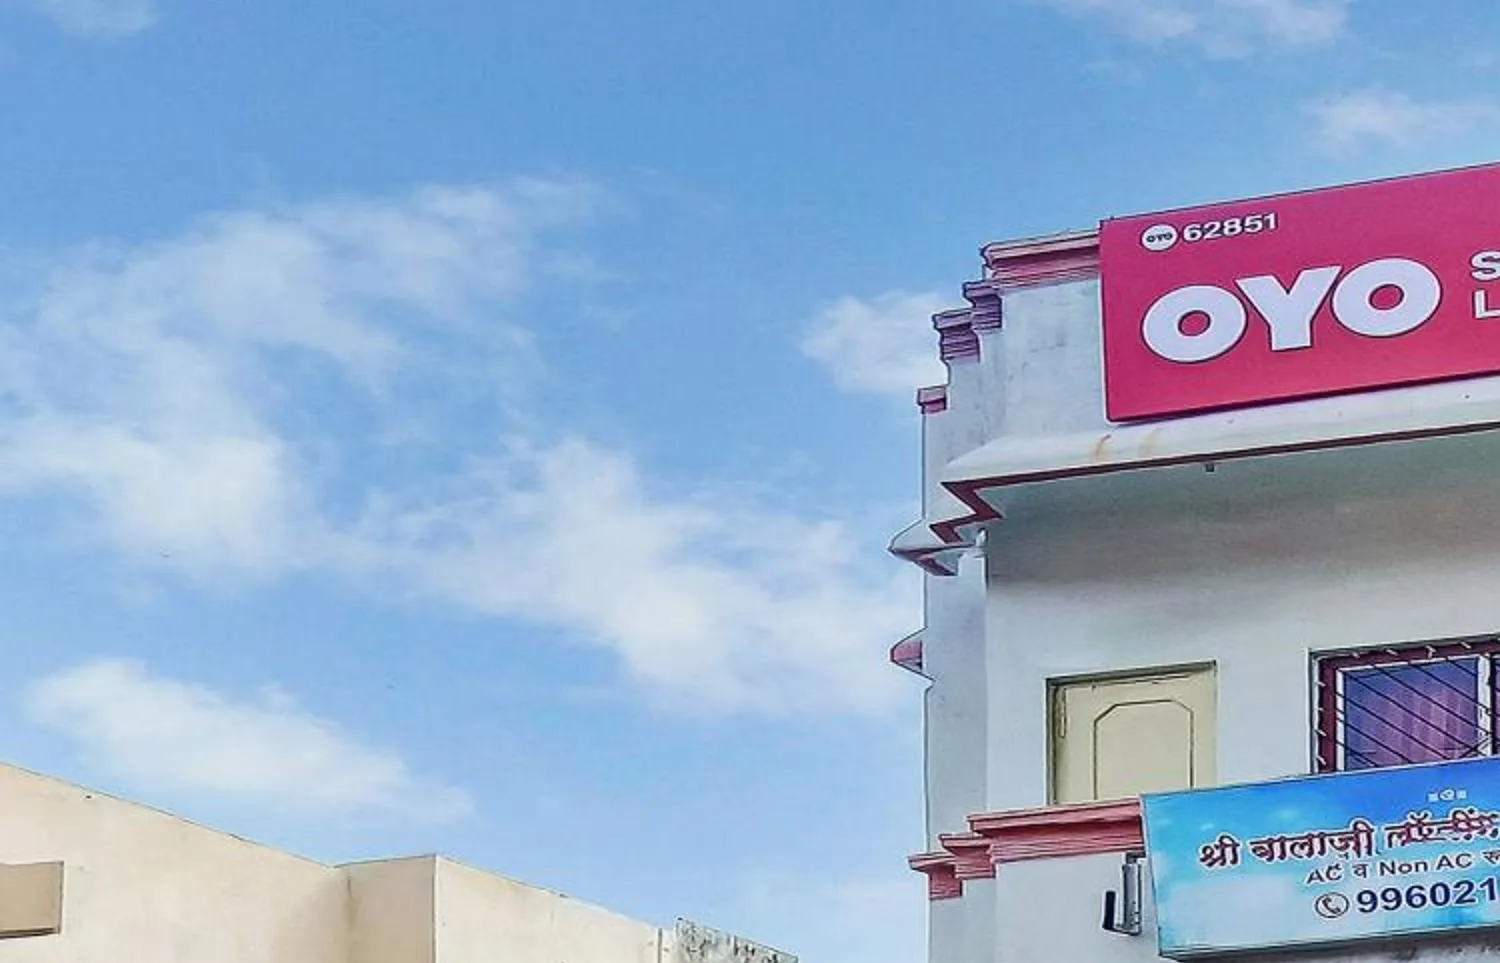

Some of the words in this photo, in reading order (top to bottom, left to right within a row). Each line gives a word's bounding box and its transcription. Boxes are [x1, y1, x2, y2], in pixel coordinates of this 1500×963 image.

[1183, 213, 1278, 242] 62851
[1142, 258, 1442, 363] OYO
[1199, 834, 1240, 869] श्री
[1306, 864, 1341, 885] AC
[1353, 861, 1368, 879] व
[1379, 858, 1428, 876] Non
[1436, 853, 1473, 871] AC
